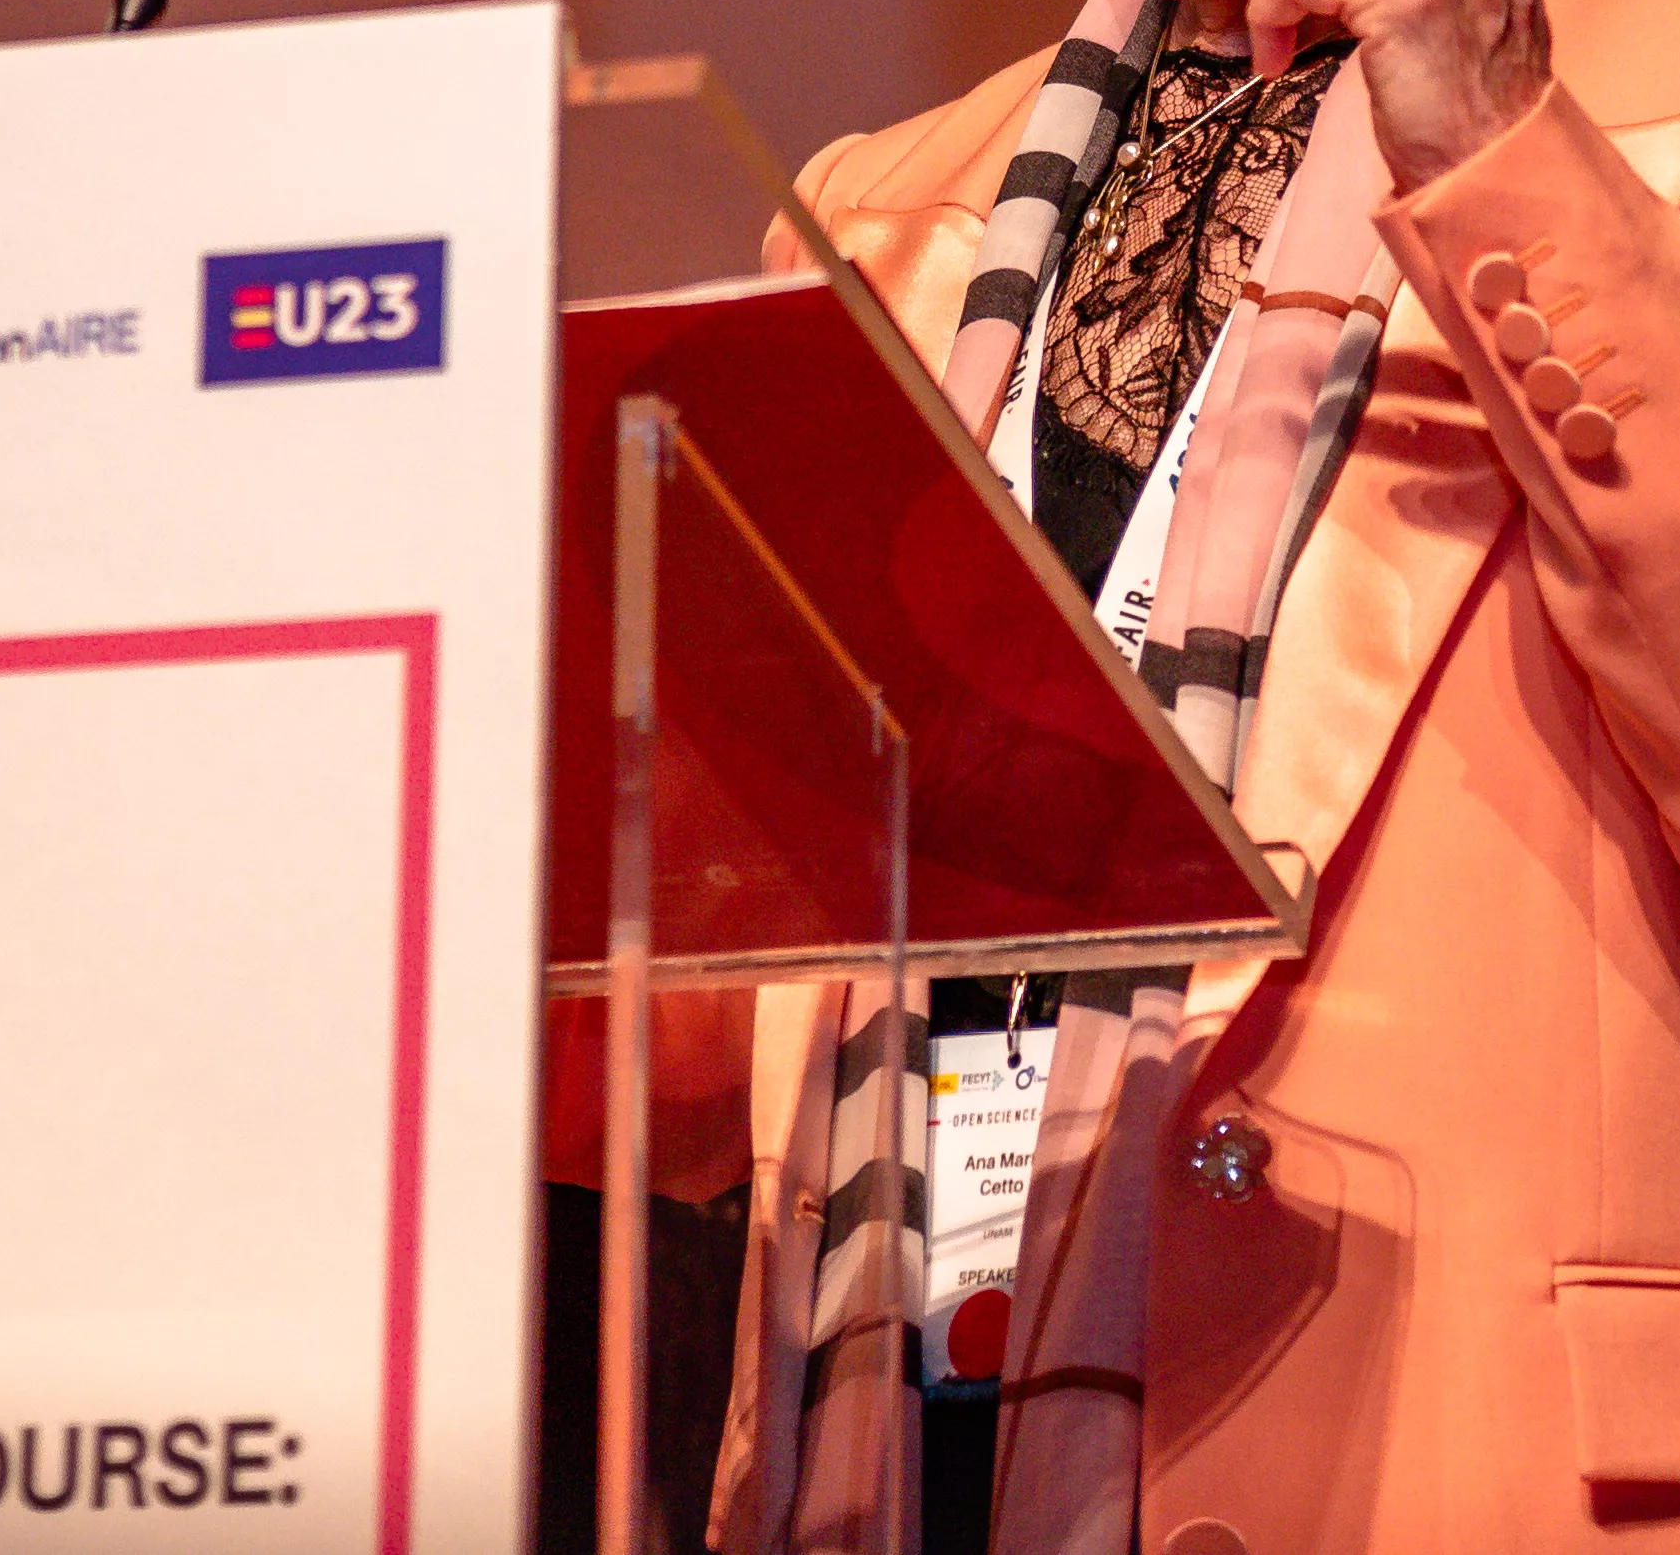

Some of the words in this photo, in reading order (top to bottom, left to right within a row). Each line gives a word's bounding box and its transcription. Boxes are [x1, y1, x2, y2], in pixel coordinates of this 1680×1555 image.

[952, 1112, 984, 1128] OPEN
[986, 1107, 1038, 1125] SCIENCE
[964, 1155, 996, 1171] Ana
[979, 1178, 1024, 1196] Cetto
